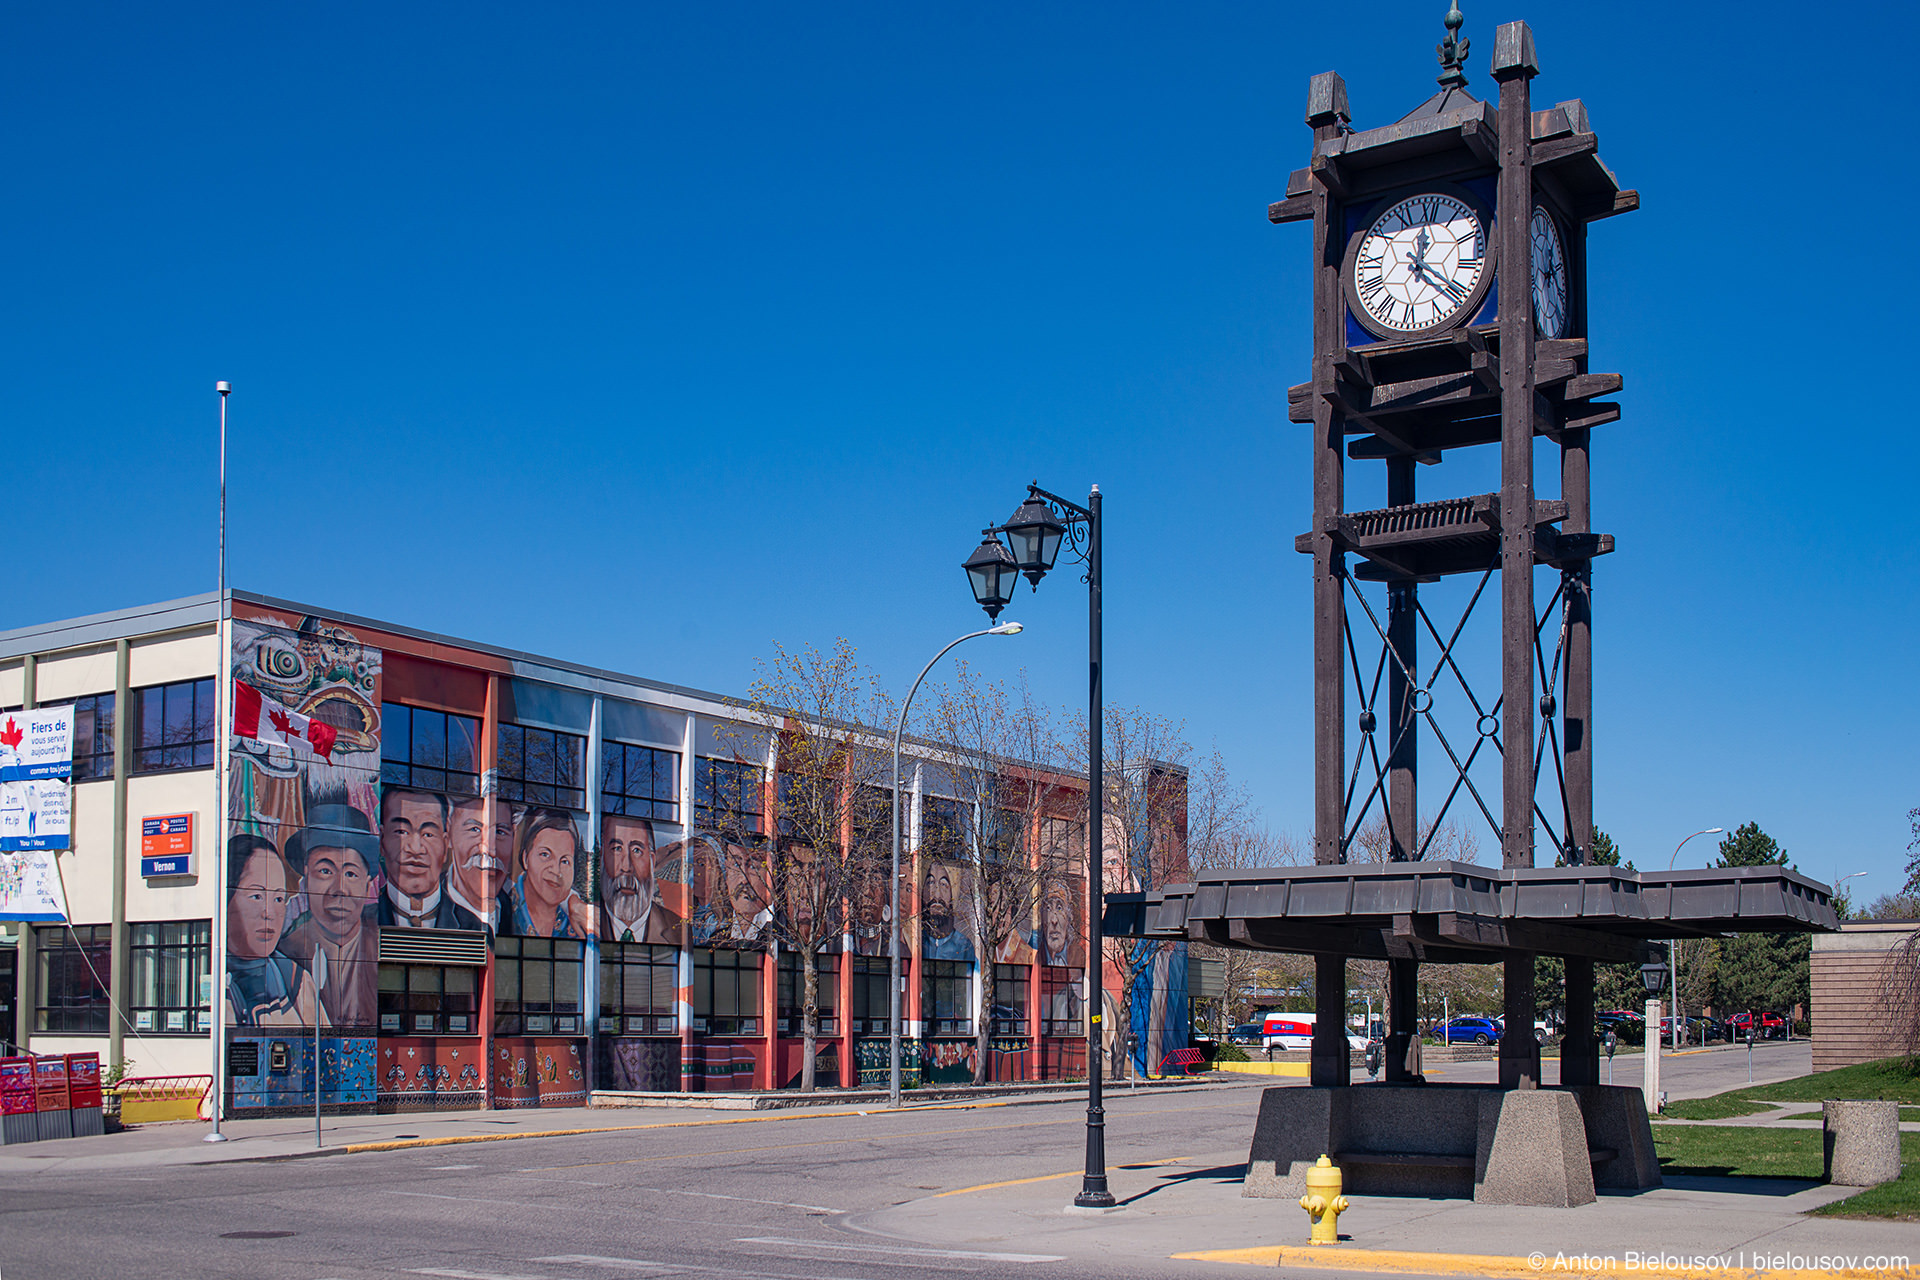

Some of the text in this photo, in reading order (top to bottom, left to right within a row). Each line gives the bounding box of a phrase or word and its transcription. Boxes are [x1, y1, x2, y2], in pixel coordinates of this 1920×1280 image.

[31, 719, 67, 734] Fiers de
[47, 735, 65, 744] servir
[31, 743, 67, 758] aujourd'hui
[30, 764, 72, 775] comme toujour
[153, 861, 176, 872] Vernon
